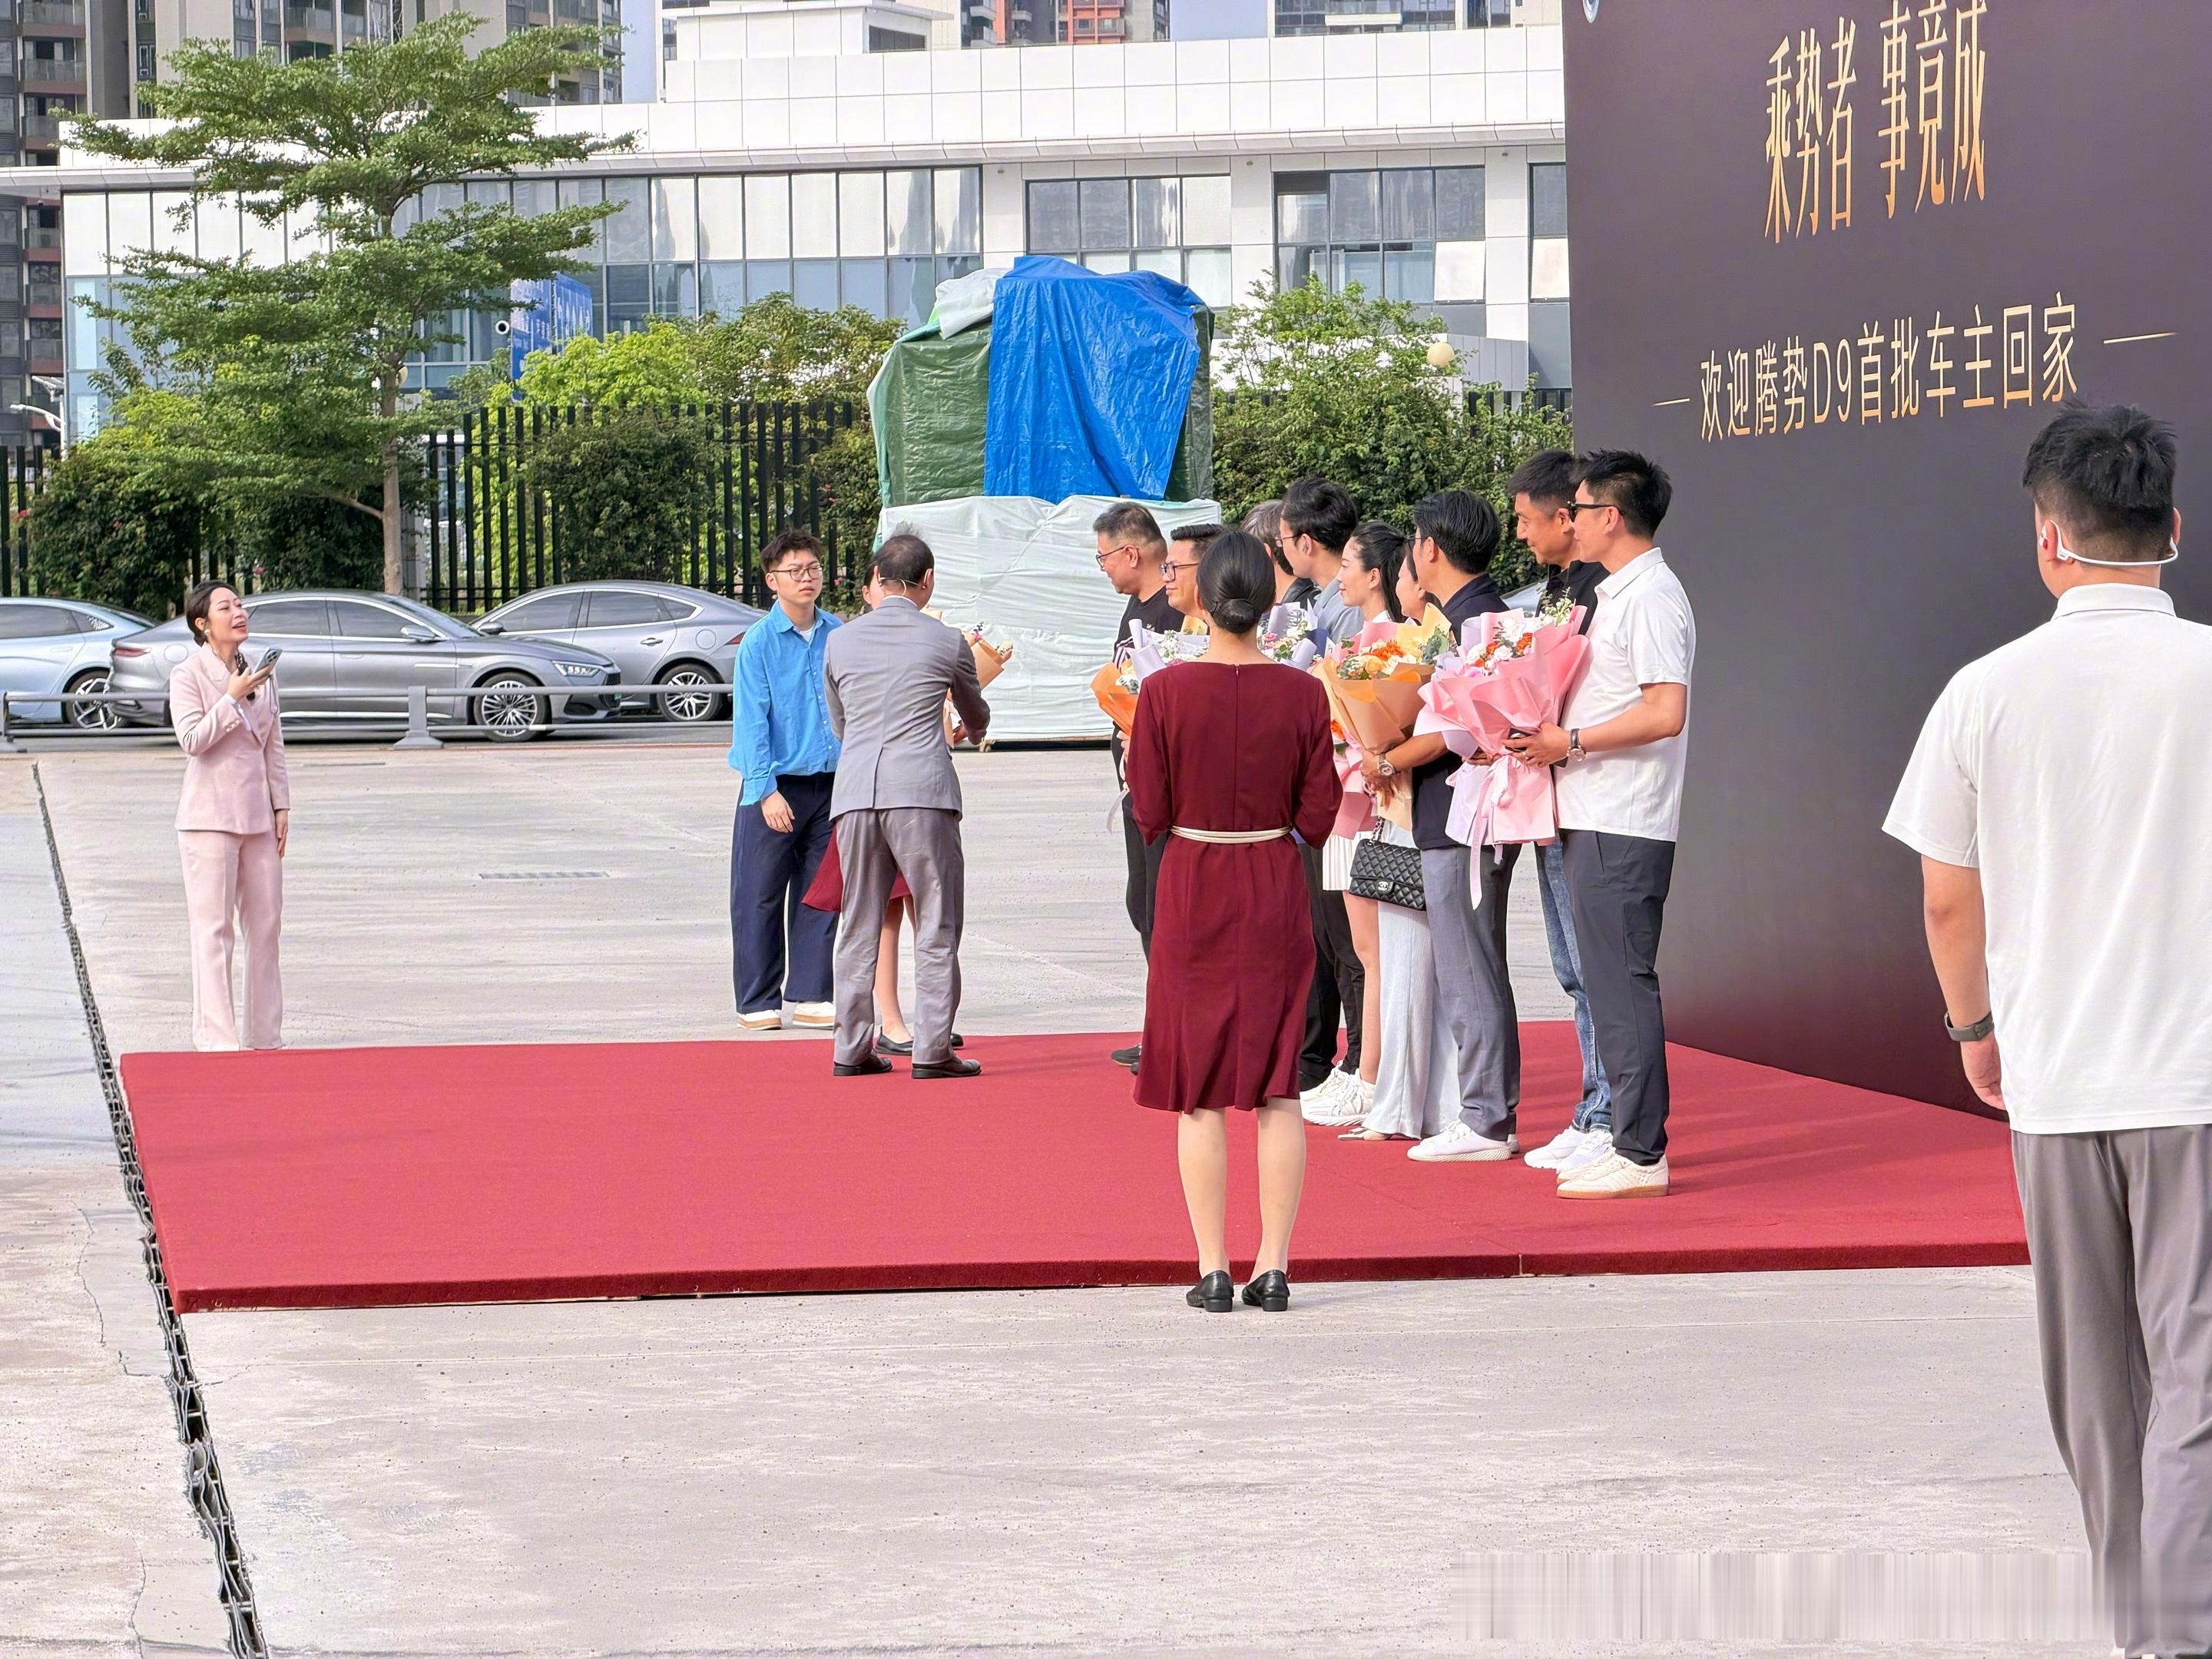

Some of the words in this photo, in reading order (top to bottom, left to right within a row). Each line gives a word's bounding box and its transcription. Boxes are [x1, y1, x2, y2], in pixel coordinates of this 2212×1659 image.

[1764, 17, 1857, 244] 乘势者
[1878, 0, 1988, 219] 事竟成
[1700, 291, 2078, 442] 欢迎腾势D9首批车主回家
